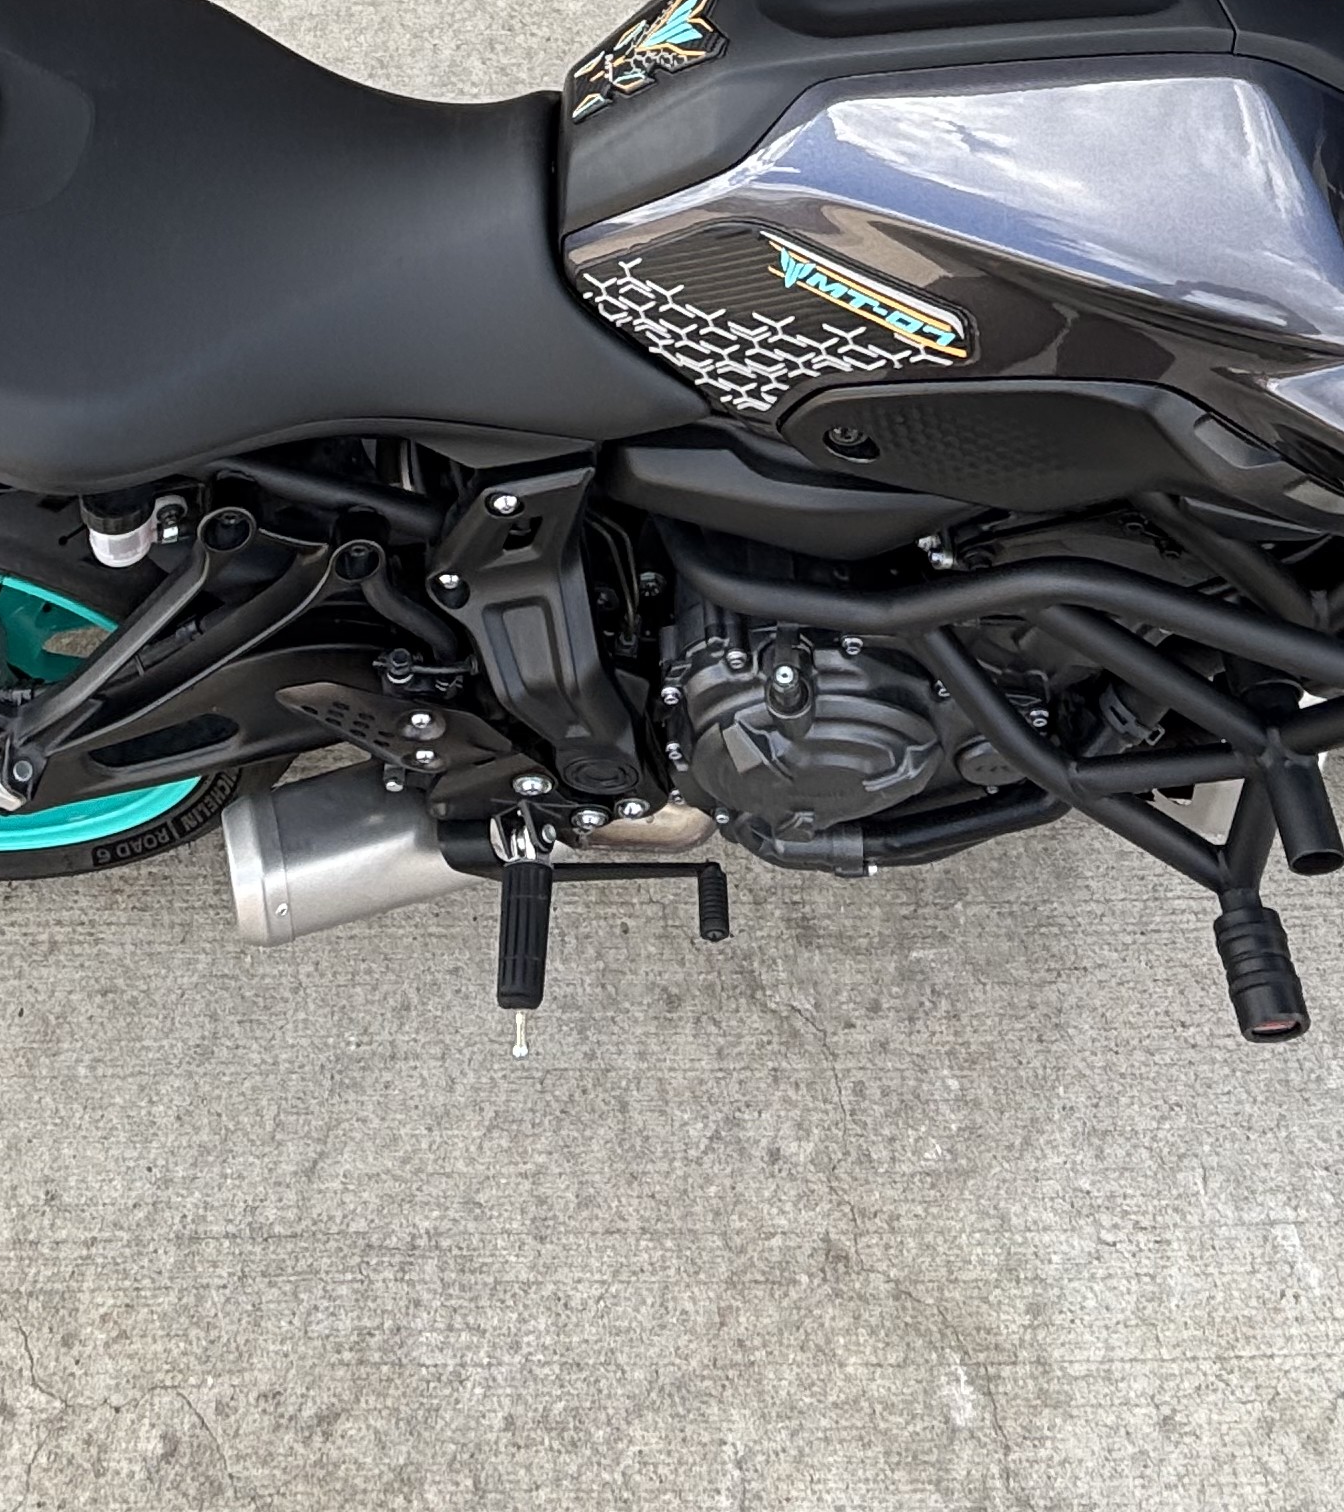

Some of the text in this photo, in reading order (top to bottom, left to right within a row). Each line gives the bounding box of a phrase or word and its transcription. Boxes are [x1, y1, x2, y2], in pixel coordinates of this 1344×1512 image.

[806, 272, 956, 347] MT-07
[96, 848, 111, 864] 6
[116, 824, 170, 858] ROAD
